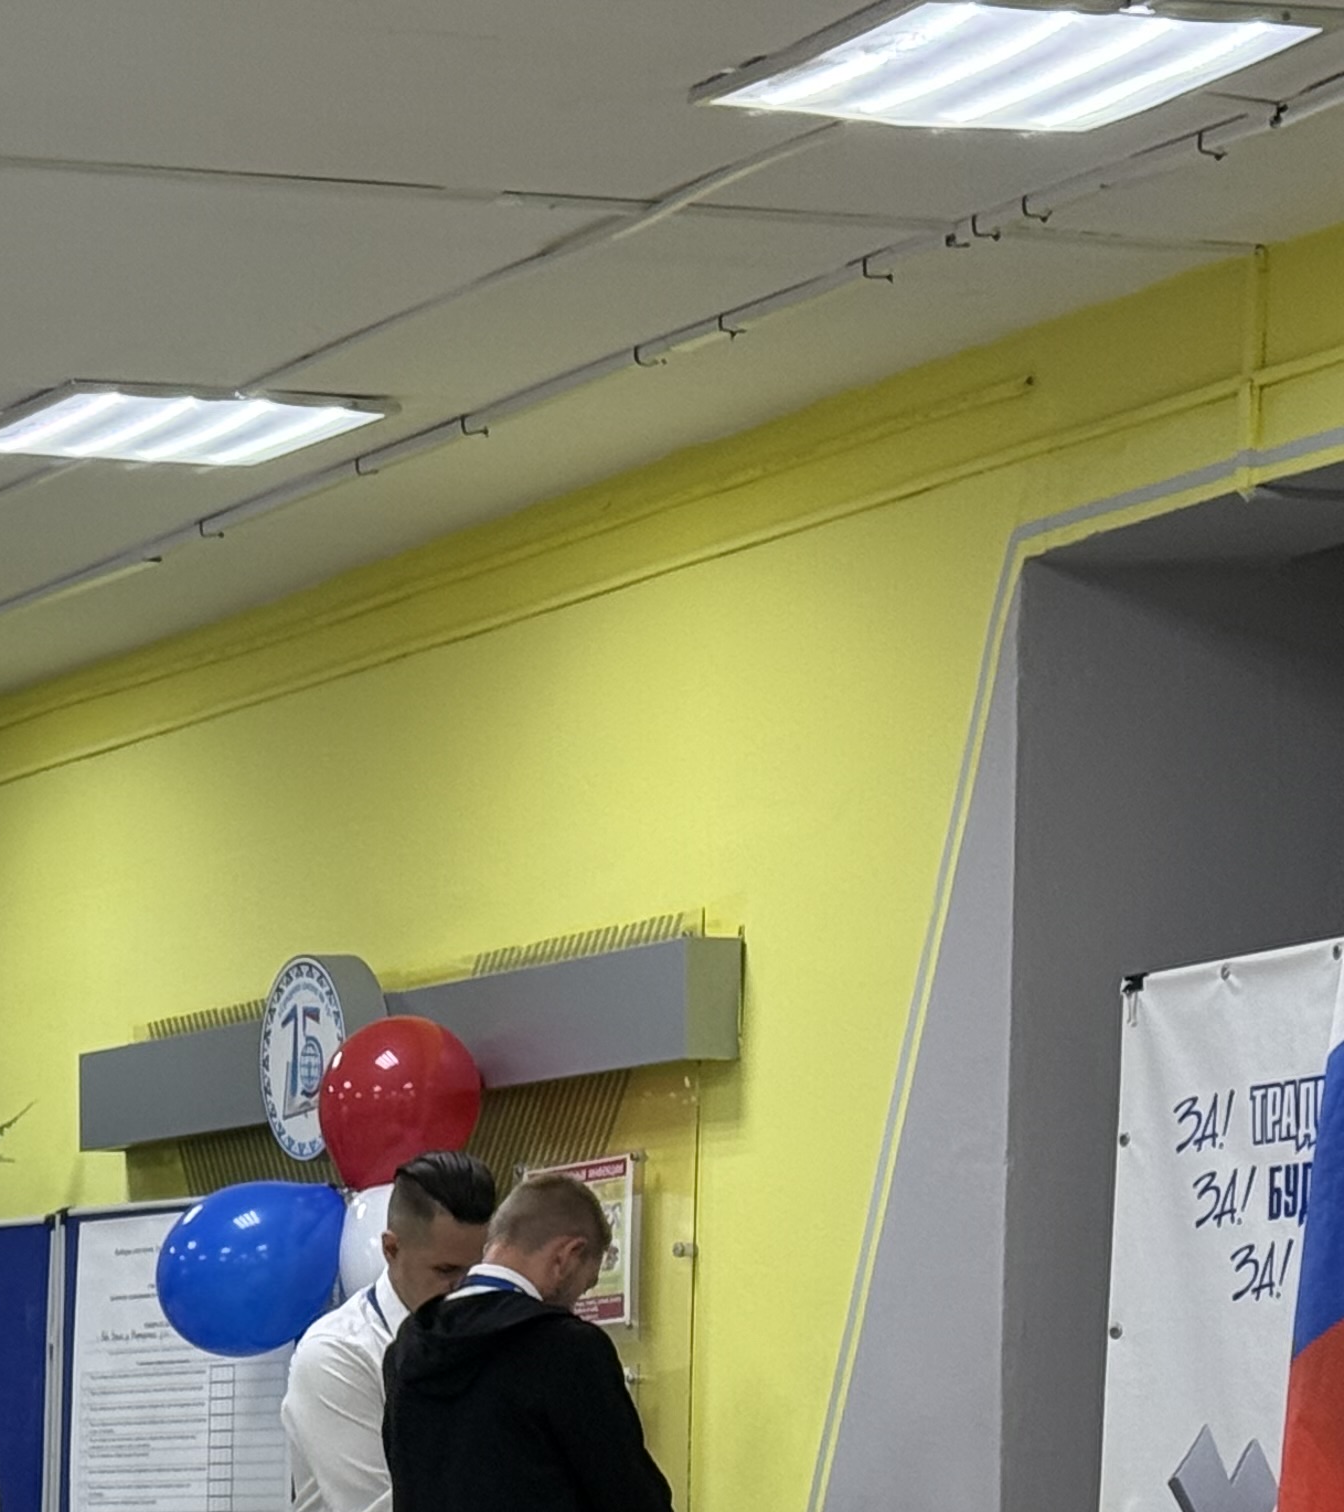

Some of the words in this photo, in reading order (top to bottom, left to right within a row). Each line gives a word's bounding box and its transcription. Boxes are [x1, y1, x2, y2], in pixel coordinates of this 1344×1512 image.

[1173, 1088, 1235, 1153] ЗА!
[1192, 1165, 1257, 1228] ЗА!
[1230, 1238, 1294, 1301] ЗА!
